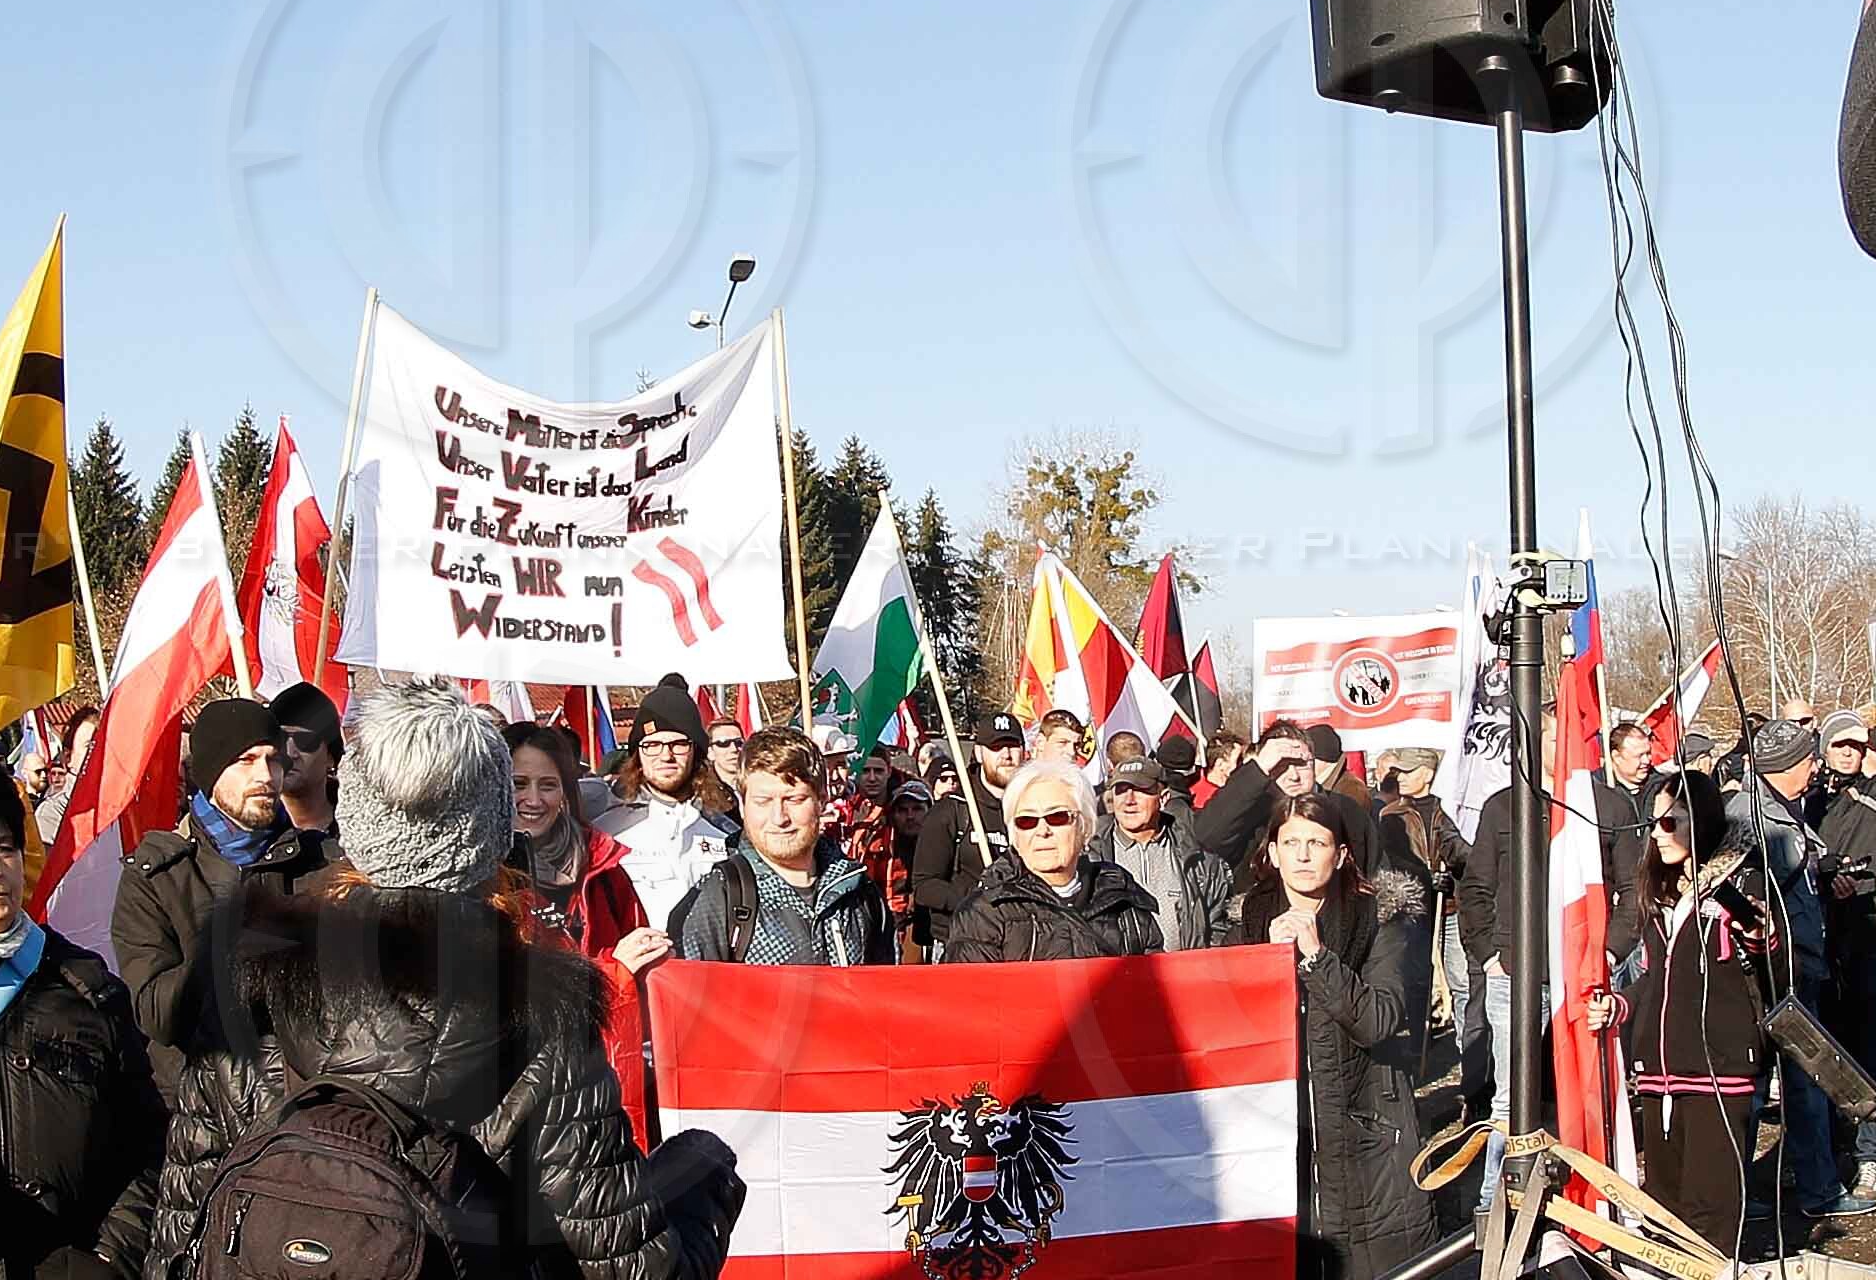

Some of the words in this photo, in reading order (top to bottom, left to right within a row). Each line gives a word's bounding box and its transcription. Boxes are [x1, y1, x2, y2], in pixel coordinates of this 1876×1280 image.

[435, 385, 504, 436] Unsere
[435, 430, 494, 482] Unser
[574, 466, 600, 498] ist
[601, 473, 632, 498] das
[634, 432, 691, 483] Land
[470, 506, 496, 539] die
[627, 493, 688, 534] Kinder
[511, 556, 566, 598] WIR
[584, 576, 623, 597] nun
